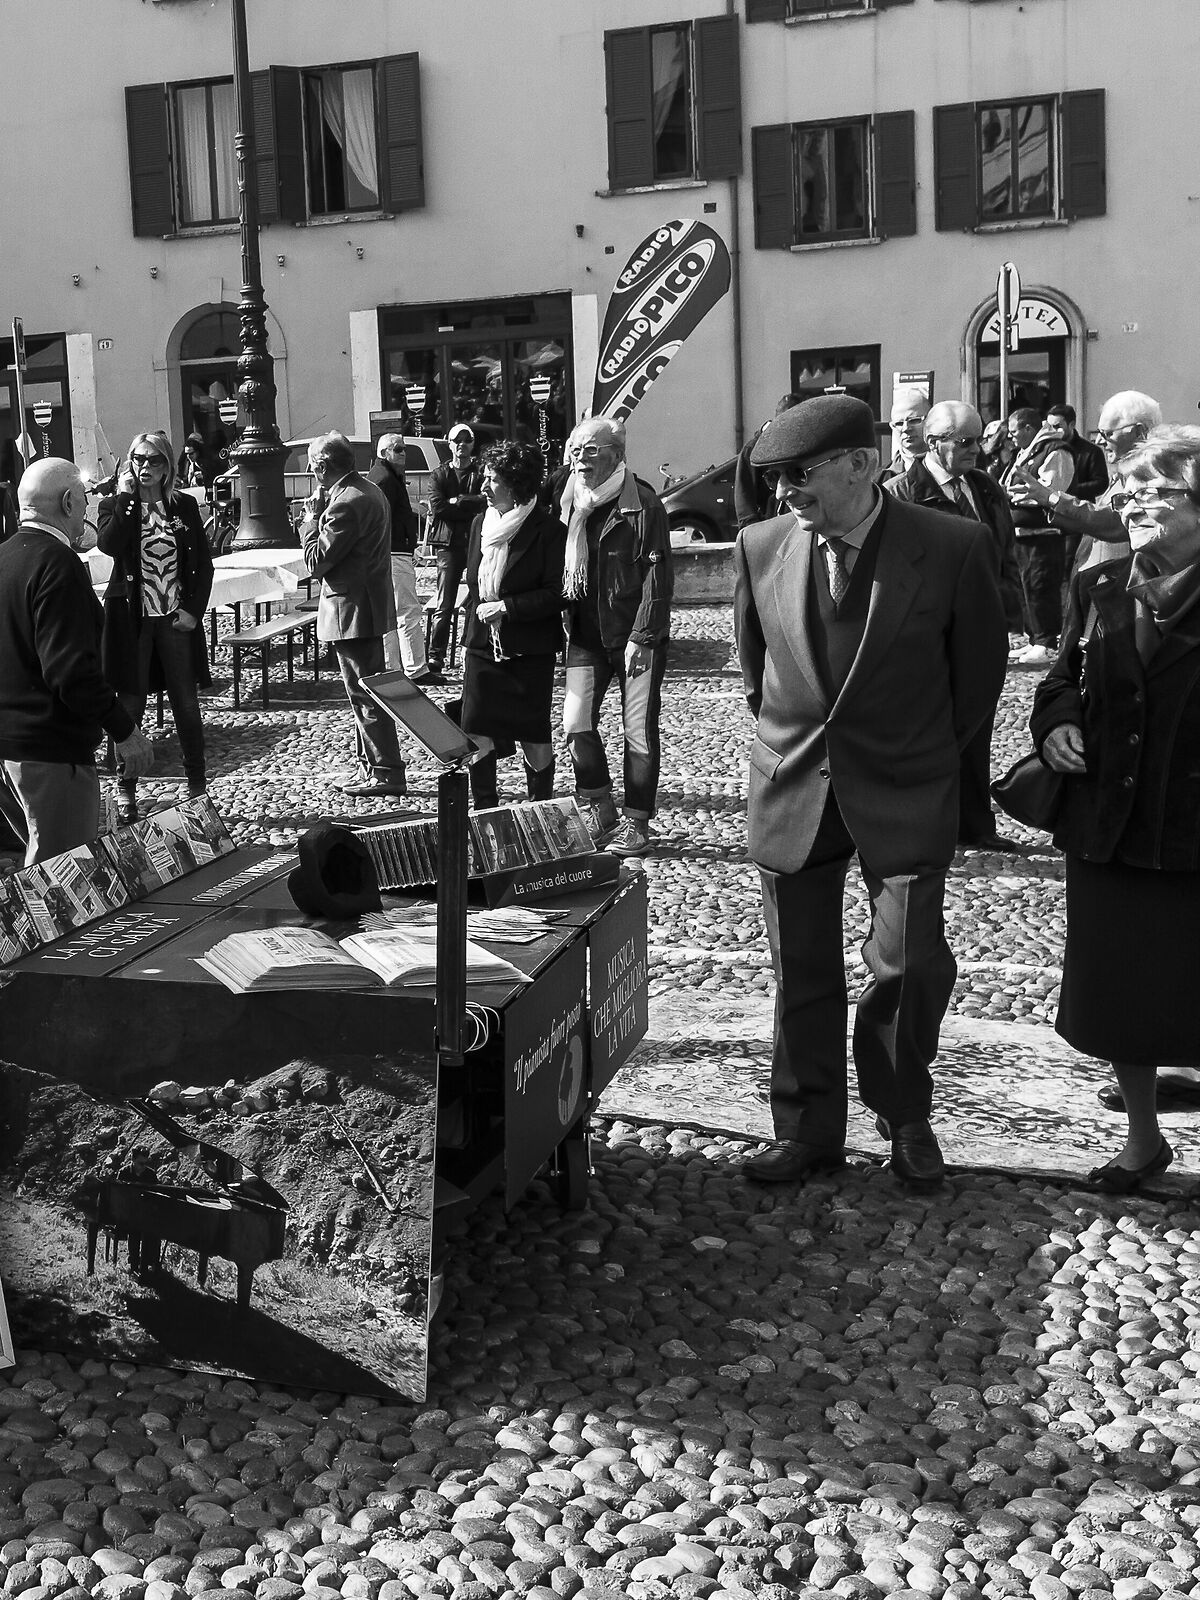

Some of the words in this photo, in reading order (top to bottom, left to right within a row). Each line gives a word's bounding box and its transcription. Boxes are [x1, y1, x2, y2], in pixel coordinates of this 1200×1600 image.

[620, 228, 671, 285] RADIO
[604, 318, 650, 375] RADIO
[639, 252, 706, 324] PICO
[989, 306, 1058, 335] HTEL
[513, 883, 525, 895] La
[526, 877, 554, 893] musica
[555, 872, 568, 886] del
[568, 869, 593, 883] cuore
[41, 947, 87, 960] LA
[67, 911, 156, 946] MUSICA
[88, 946, 125, 958] CI
[110, 917, 180, 945] SALVA
[607, 936, 636, 989] MUSICA
[594, 997, 611, 1038] CHE
[612, 956, 647, 1018] MIGLIORA
[608, 1024, 618, 1058] LA
[619, 1002, 637, 1041] VITA
